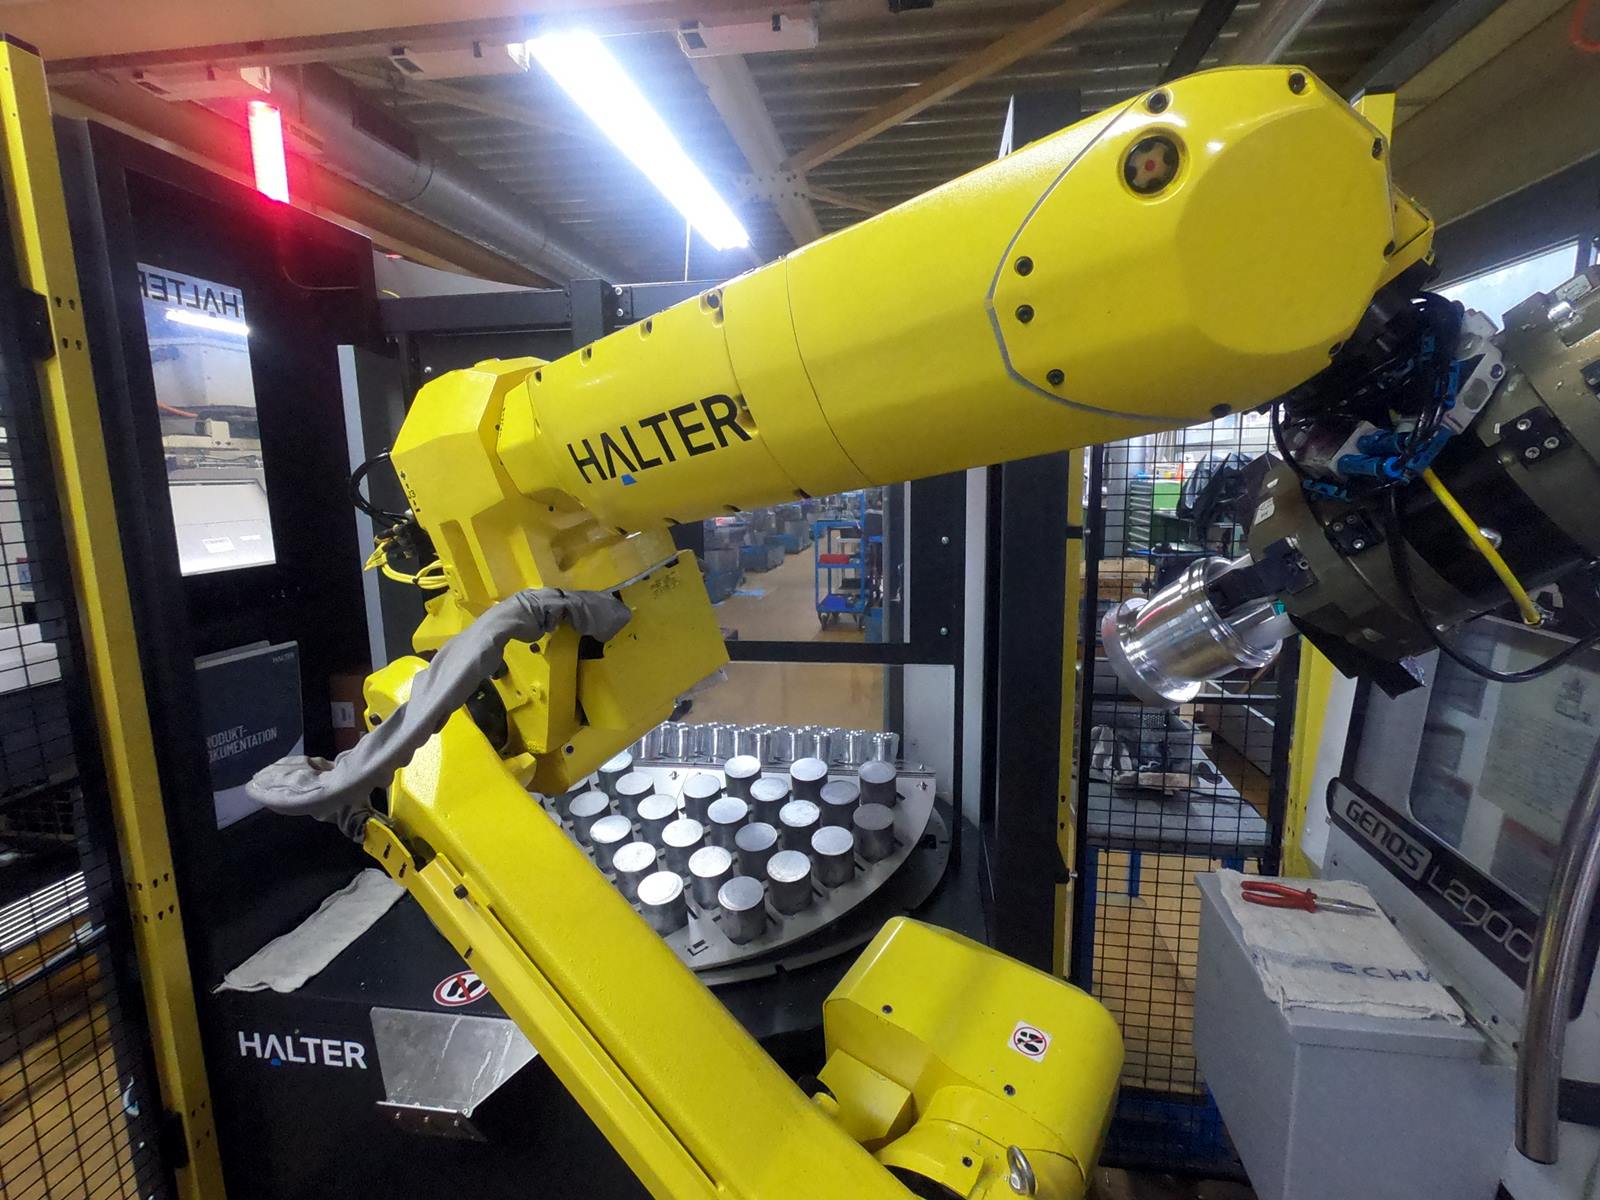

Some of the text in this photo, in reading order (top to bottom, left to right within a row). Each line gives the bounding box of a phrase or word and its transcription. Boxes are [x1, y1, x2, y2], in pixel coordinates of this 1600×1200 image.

[567, 394, 752, 485] HALTER
[1345, 800, 1534, 963] GENOS L2900
[238, 1031, 367, 1069] HALTER
